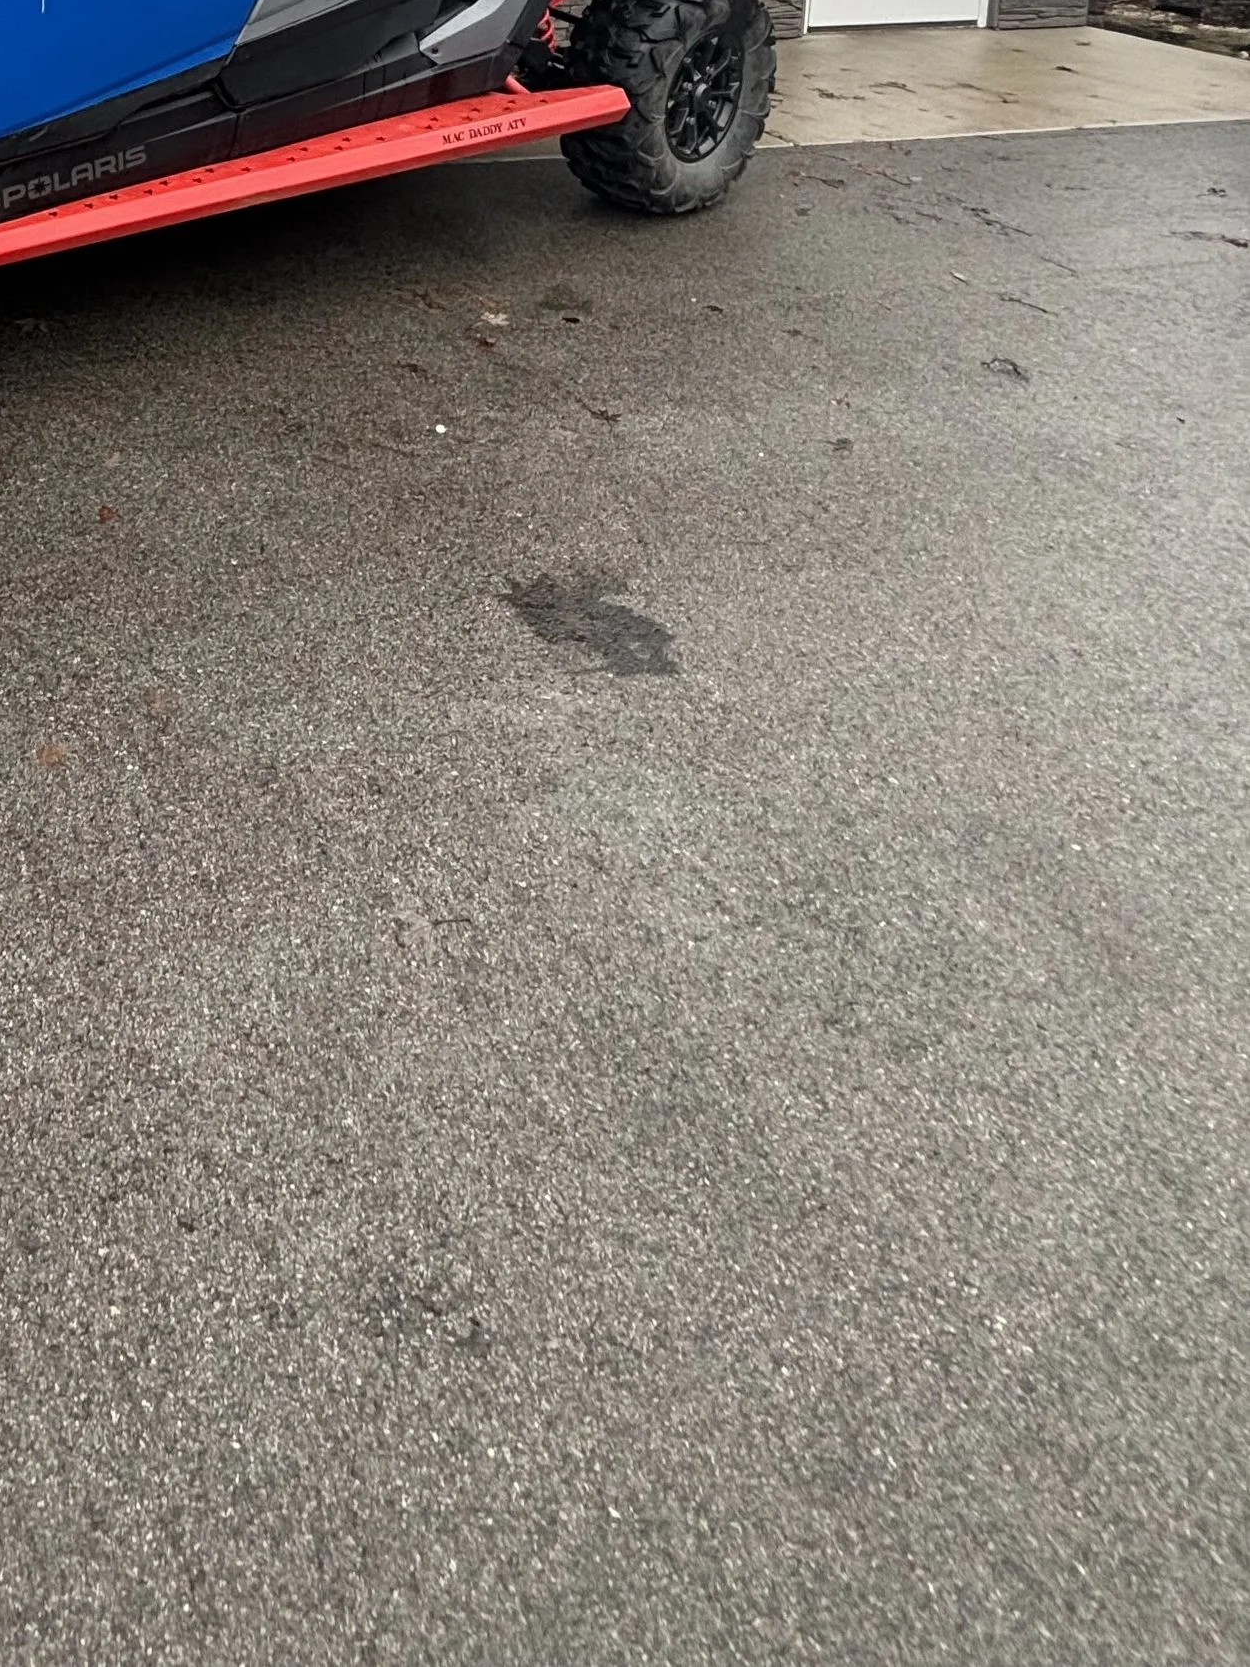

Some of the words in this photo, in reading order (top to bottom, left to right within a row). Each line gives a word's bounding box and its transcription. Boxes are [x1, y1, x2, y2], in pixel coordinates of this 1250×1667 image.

[442, 131, 466, 145] MAC
[468, 123, 503, 140] DADDY
[507, 117, 527, 131] ATV
[3, 145, 147, 209] POLARIS
